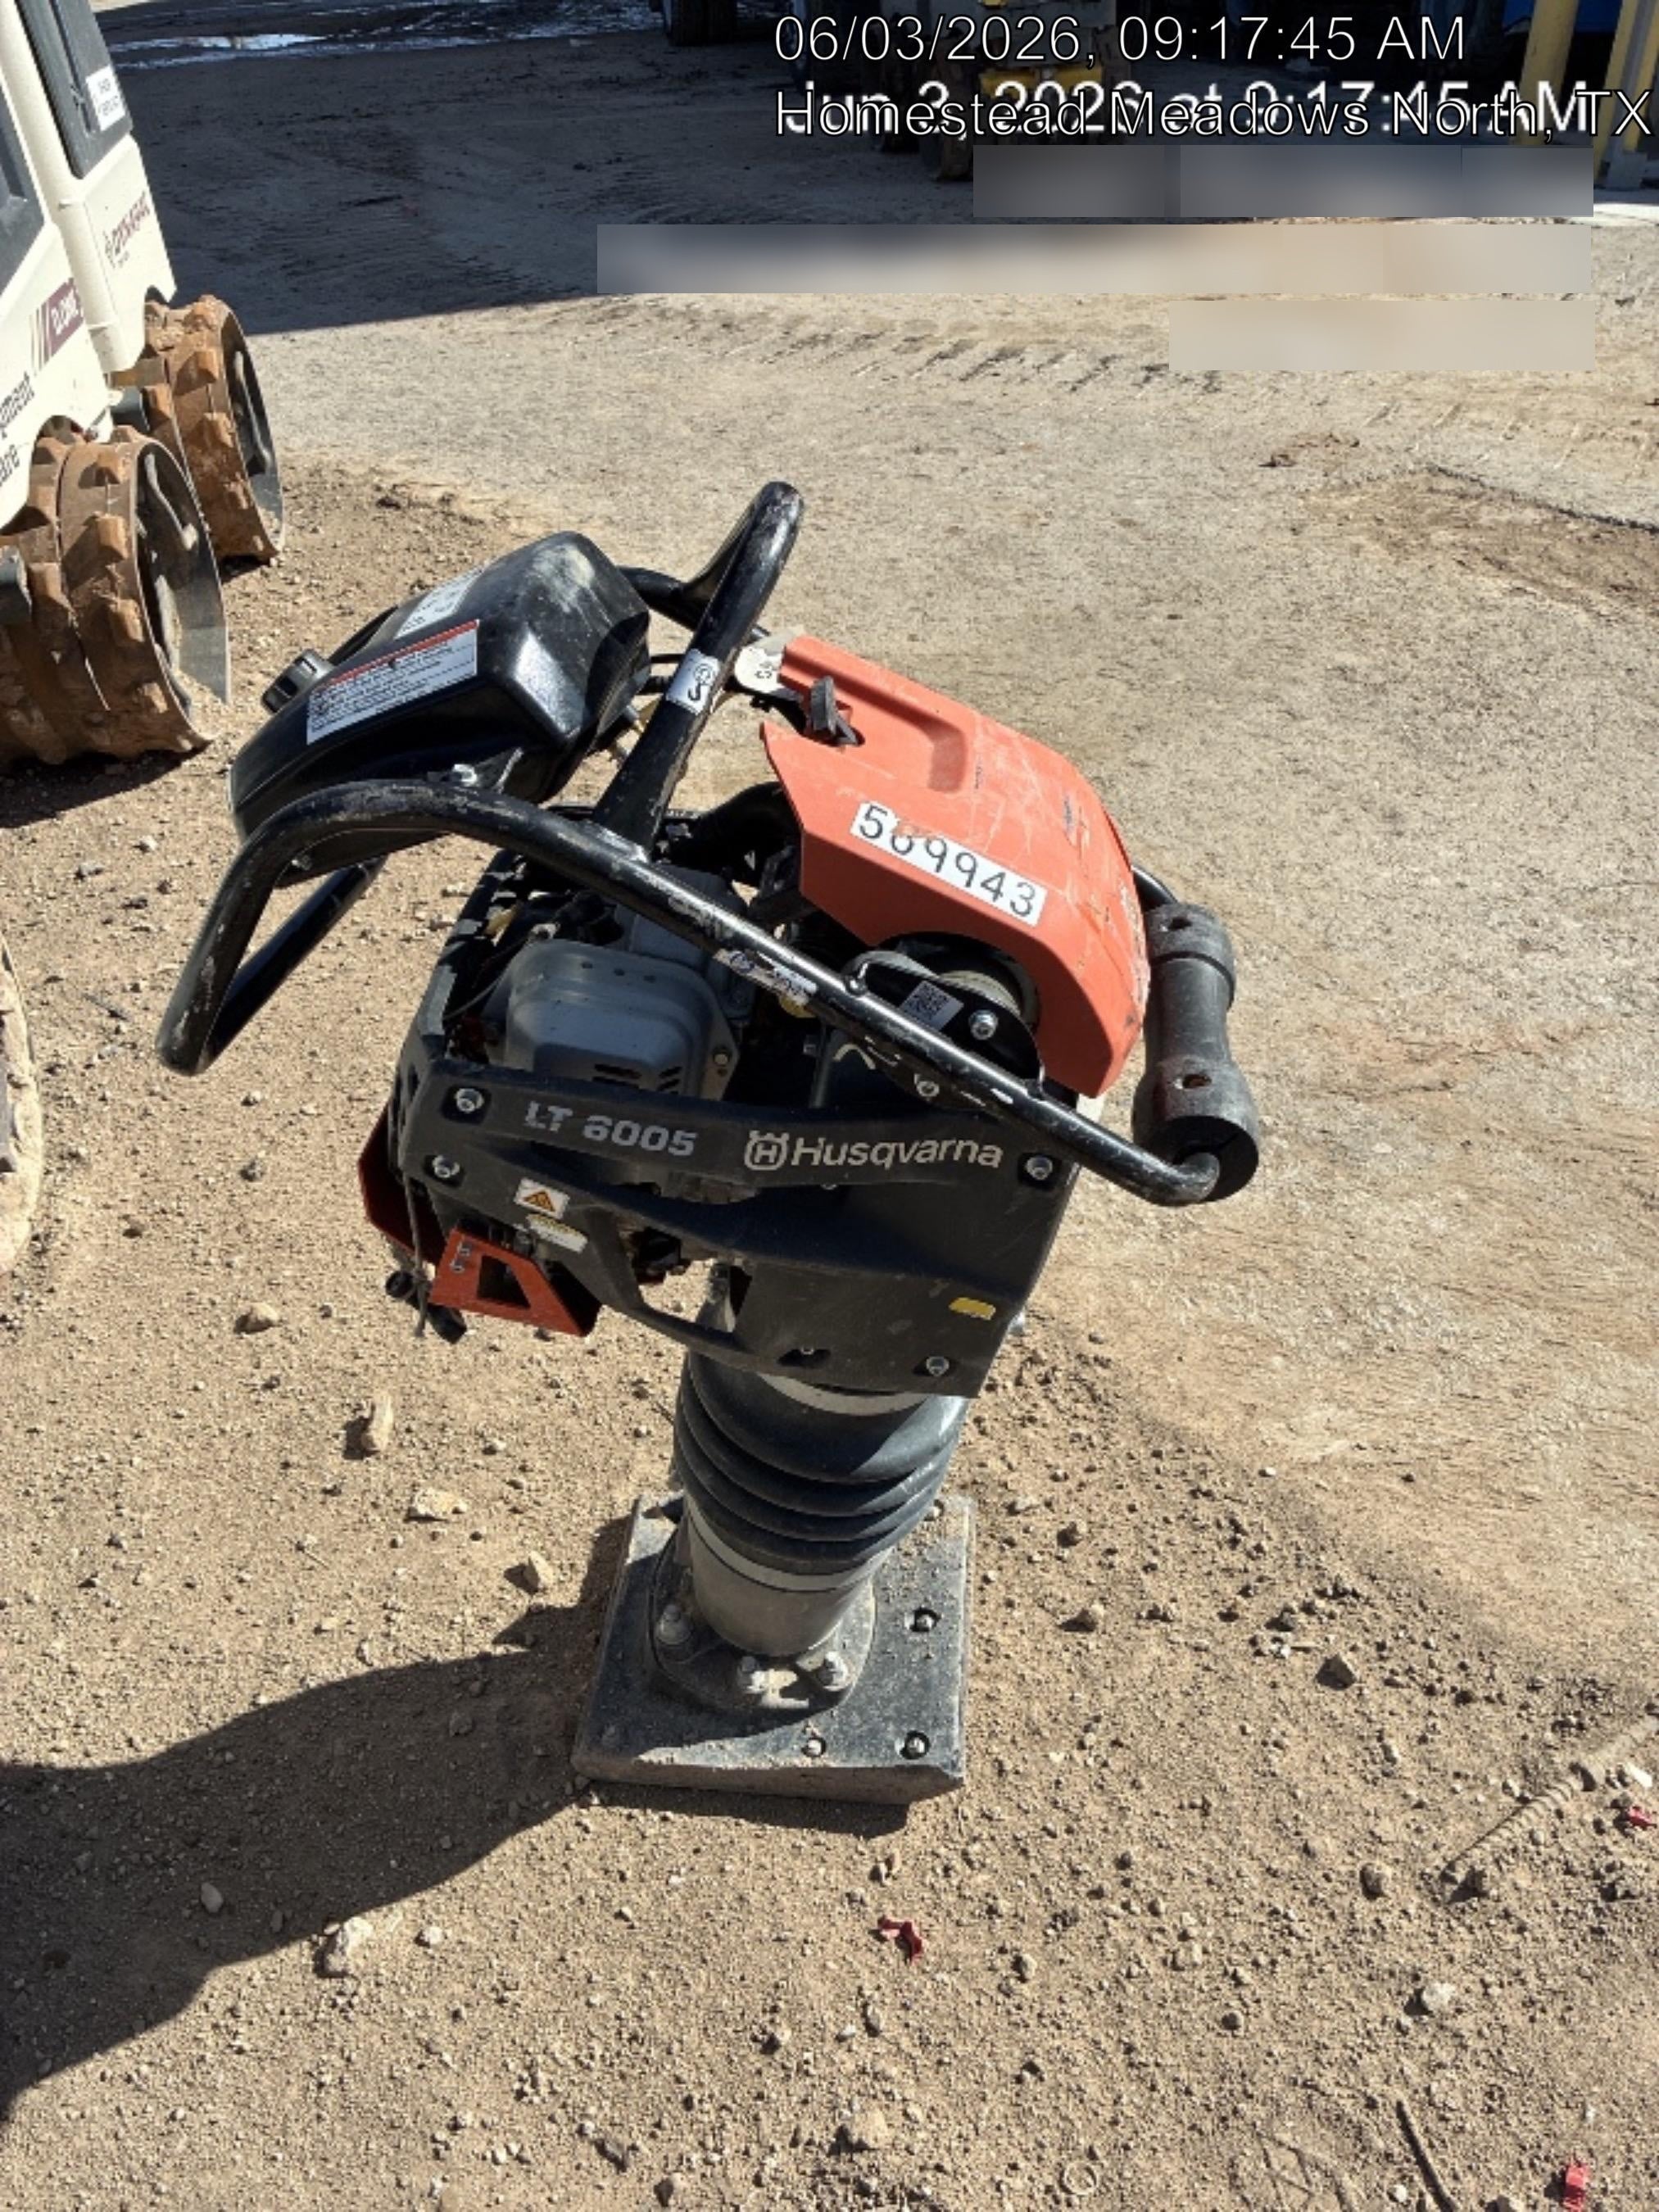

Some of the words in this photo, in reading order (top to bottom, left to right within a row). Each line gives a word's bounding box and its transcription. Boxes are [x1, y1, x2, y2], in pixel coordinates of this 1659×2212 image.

[524, 1100, 573, 1132] LT
[582, 1114, 699, 1157] 6005
[791, 1136, 1004, 1171] Husqvarna
